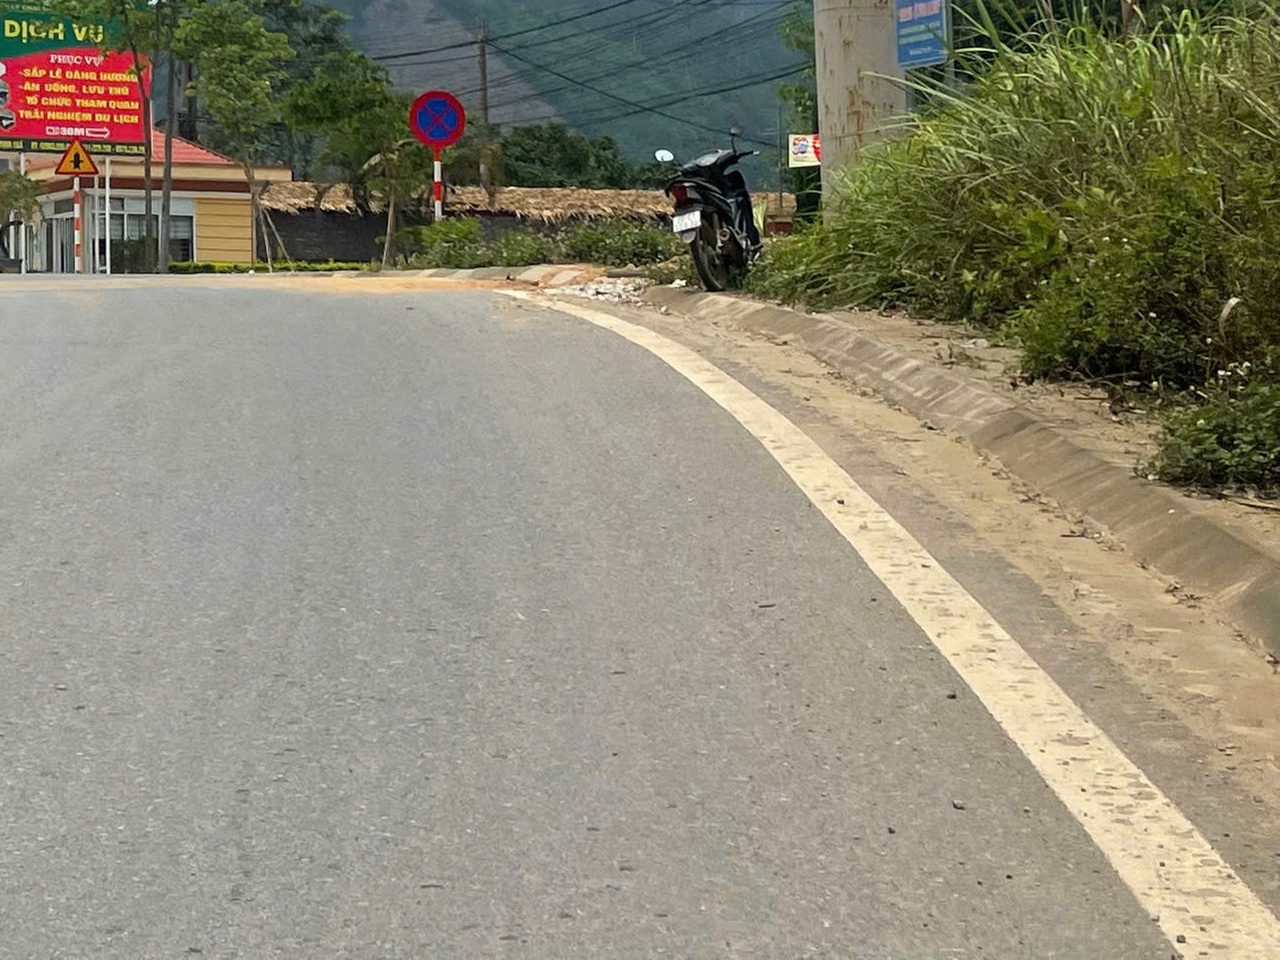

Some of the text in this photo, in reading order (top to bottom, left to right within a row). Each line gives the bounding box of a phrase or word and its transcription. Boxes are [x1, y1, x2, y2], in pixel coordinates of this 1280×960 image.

[75, 98, 107, 108] THAM
[109, 100, 139, 110] QUAN
[95, 113, 111, 123] DU
